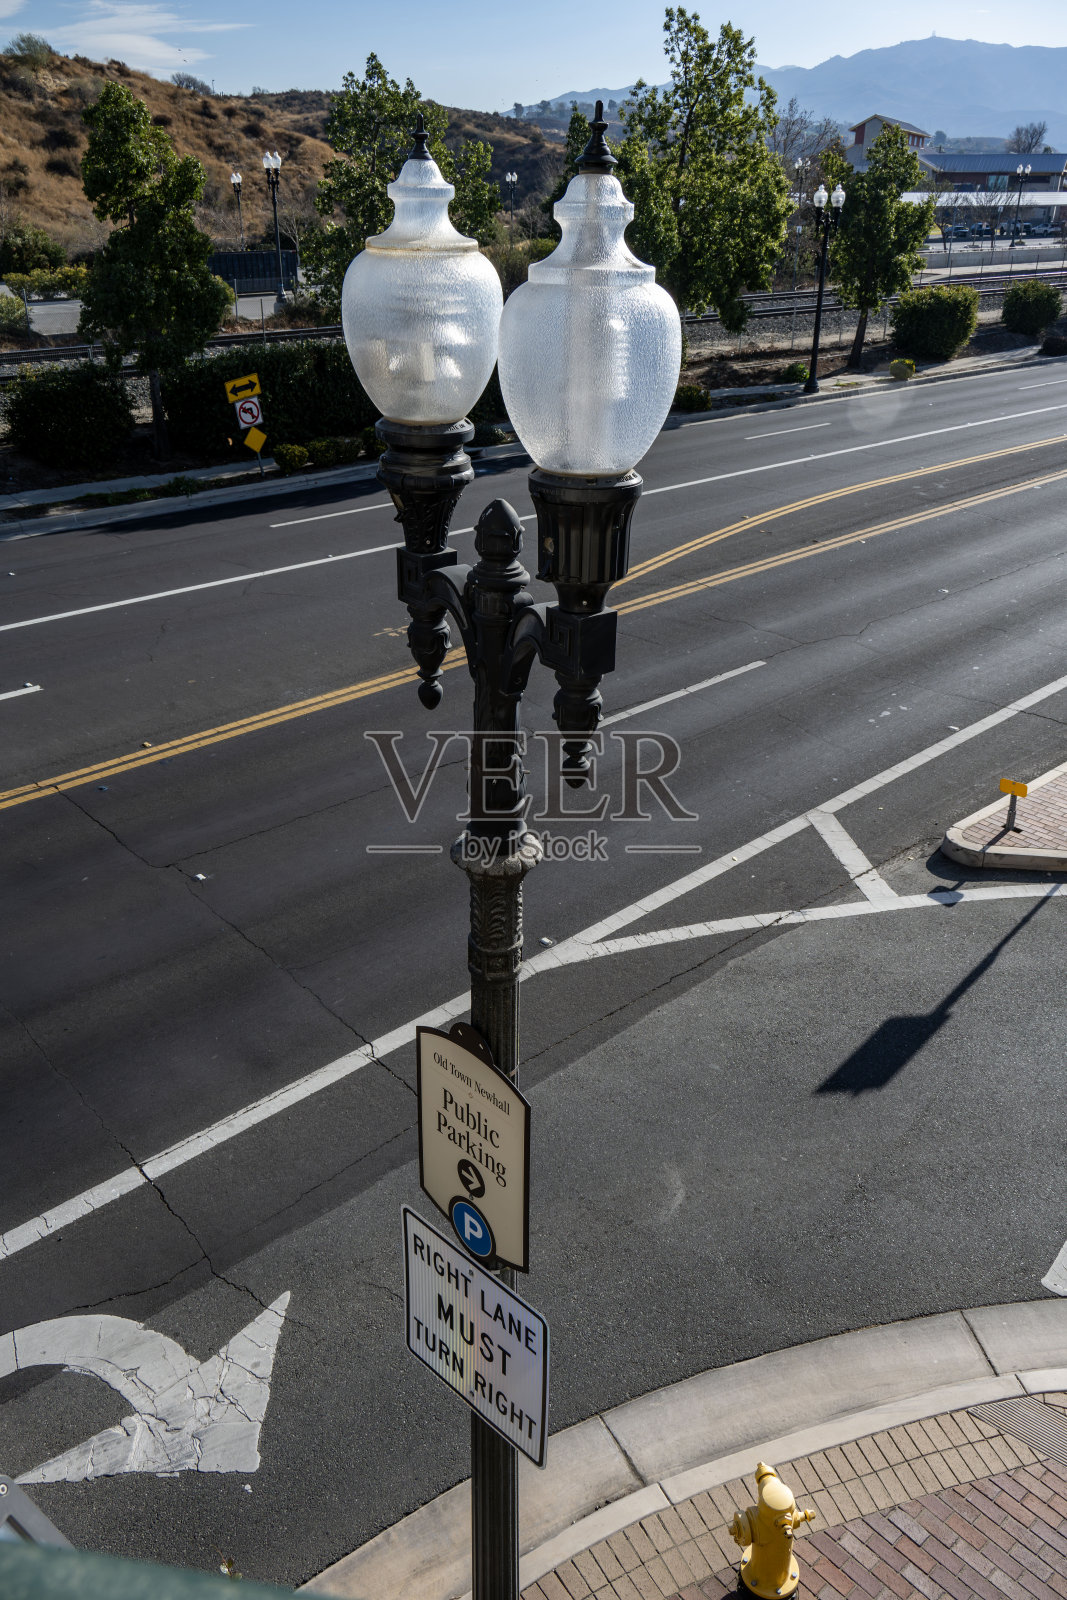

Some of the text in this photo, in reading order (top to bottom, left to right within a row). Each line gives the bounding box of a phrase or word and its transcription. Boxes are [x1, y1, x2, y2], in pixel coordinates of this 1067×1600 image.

[433, 1051, 510, 1115] Old Town Newhall
[442, 1087, 500, 1149] Public
[436, 1110, 507, 1188] Parking
[464, 1211, 483, 1241] P
[413, 1233, 537, 1356] RIGHT LANE
[437, 1294, 511, 1376] MUST
[414, 1316, 537, 1440] TURN RIGHT
